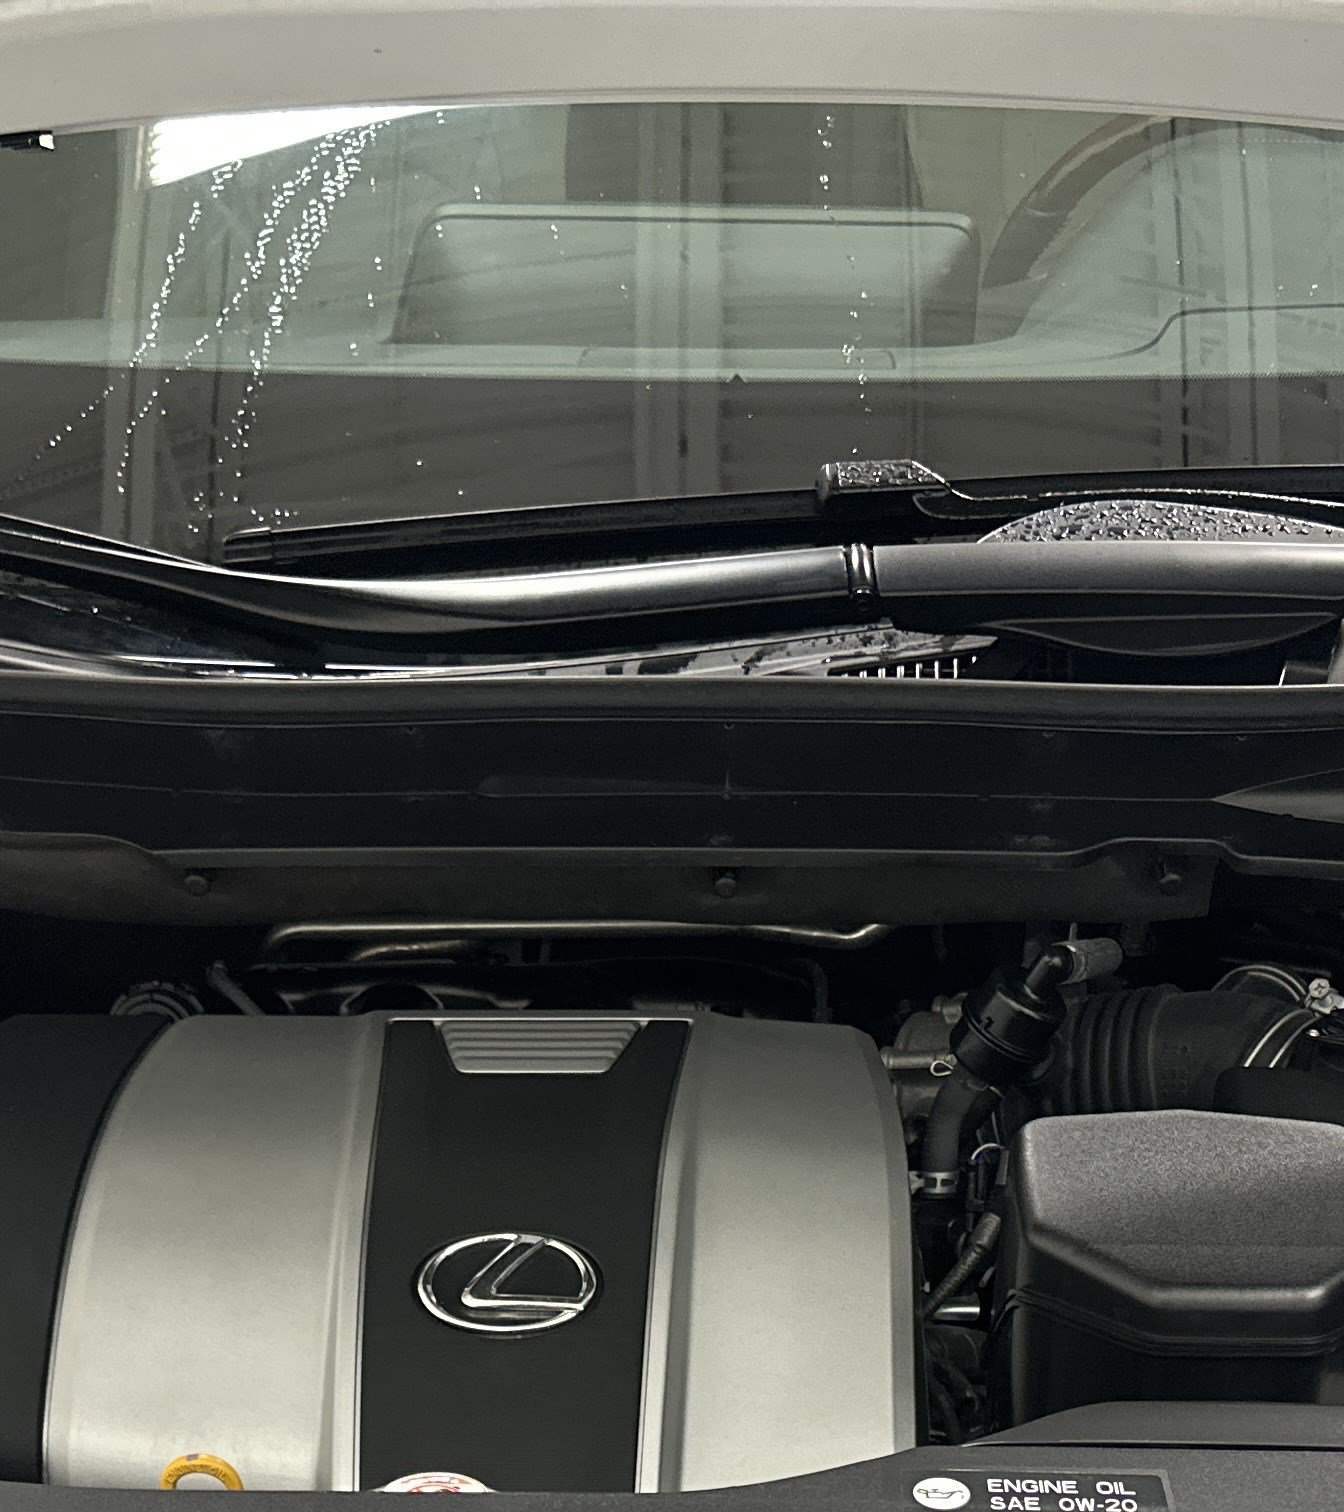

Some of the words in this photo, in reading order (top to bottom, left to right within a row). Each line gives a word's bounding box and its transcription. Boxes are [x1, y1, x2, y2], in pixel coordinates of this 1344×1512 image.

[986, 1478, 1079, 1495] ENGINE
[1095, 1481, 1136, 1496] OIL
[990, 1496, 1041, 1511] SAE
[1058, 1498, 1138, 1512] 0W-20
